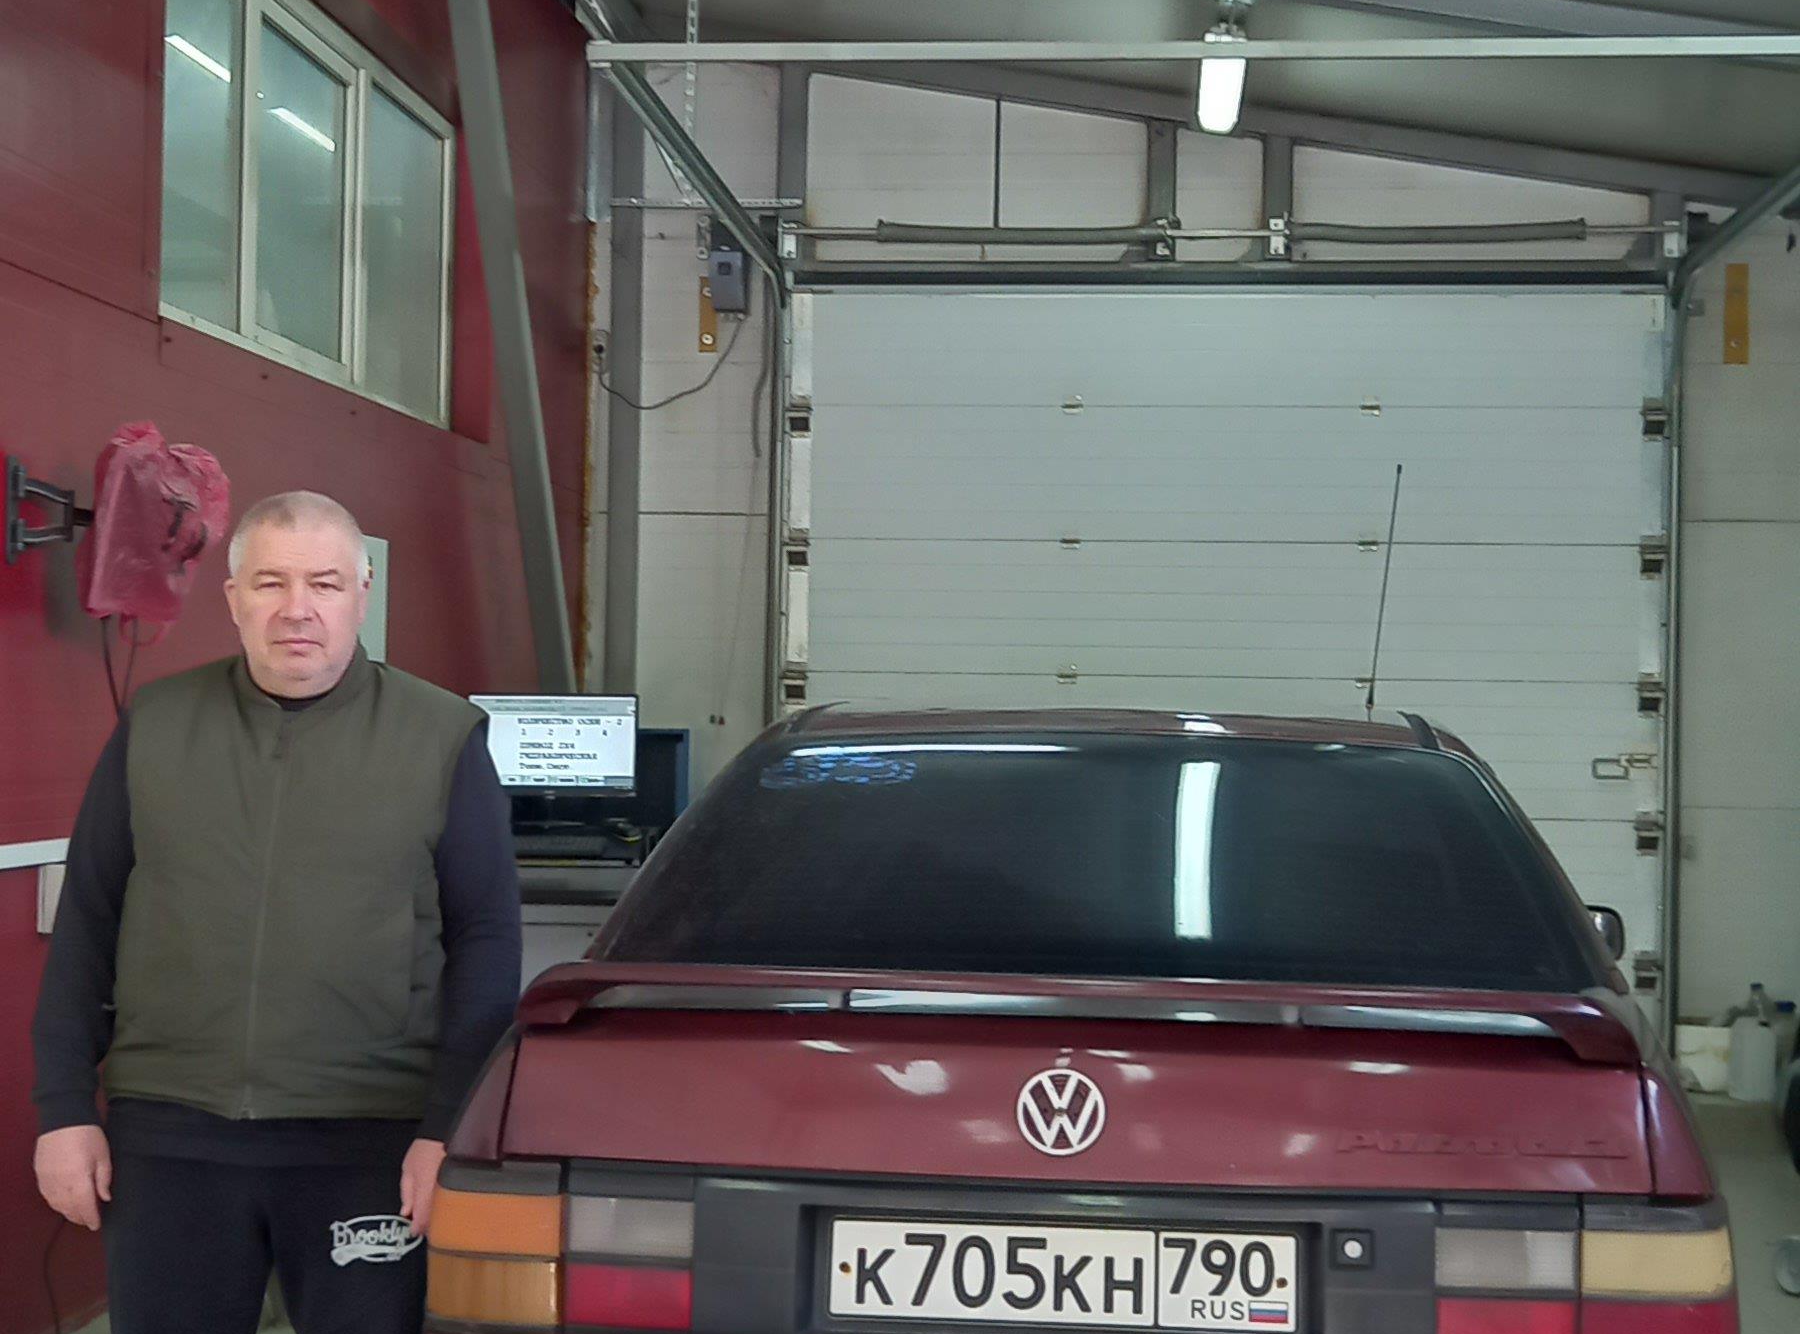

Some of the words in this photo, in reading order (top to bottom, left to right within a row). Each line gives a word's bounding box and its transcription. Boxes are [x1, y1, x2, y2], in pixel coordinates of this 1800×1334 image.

[1019, 1071, 1103, 1153] VW
[1162, 1238, 1275, 1297] 790
[1190, 1299, 1245, 1321] RUS
